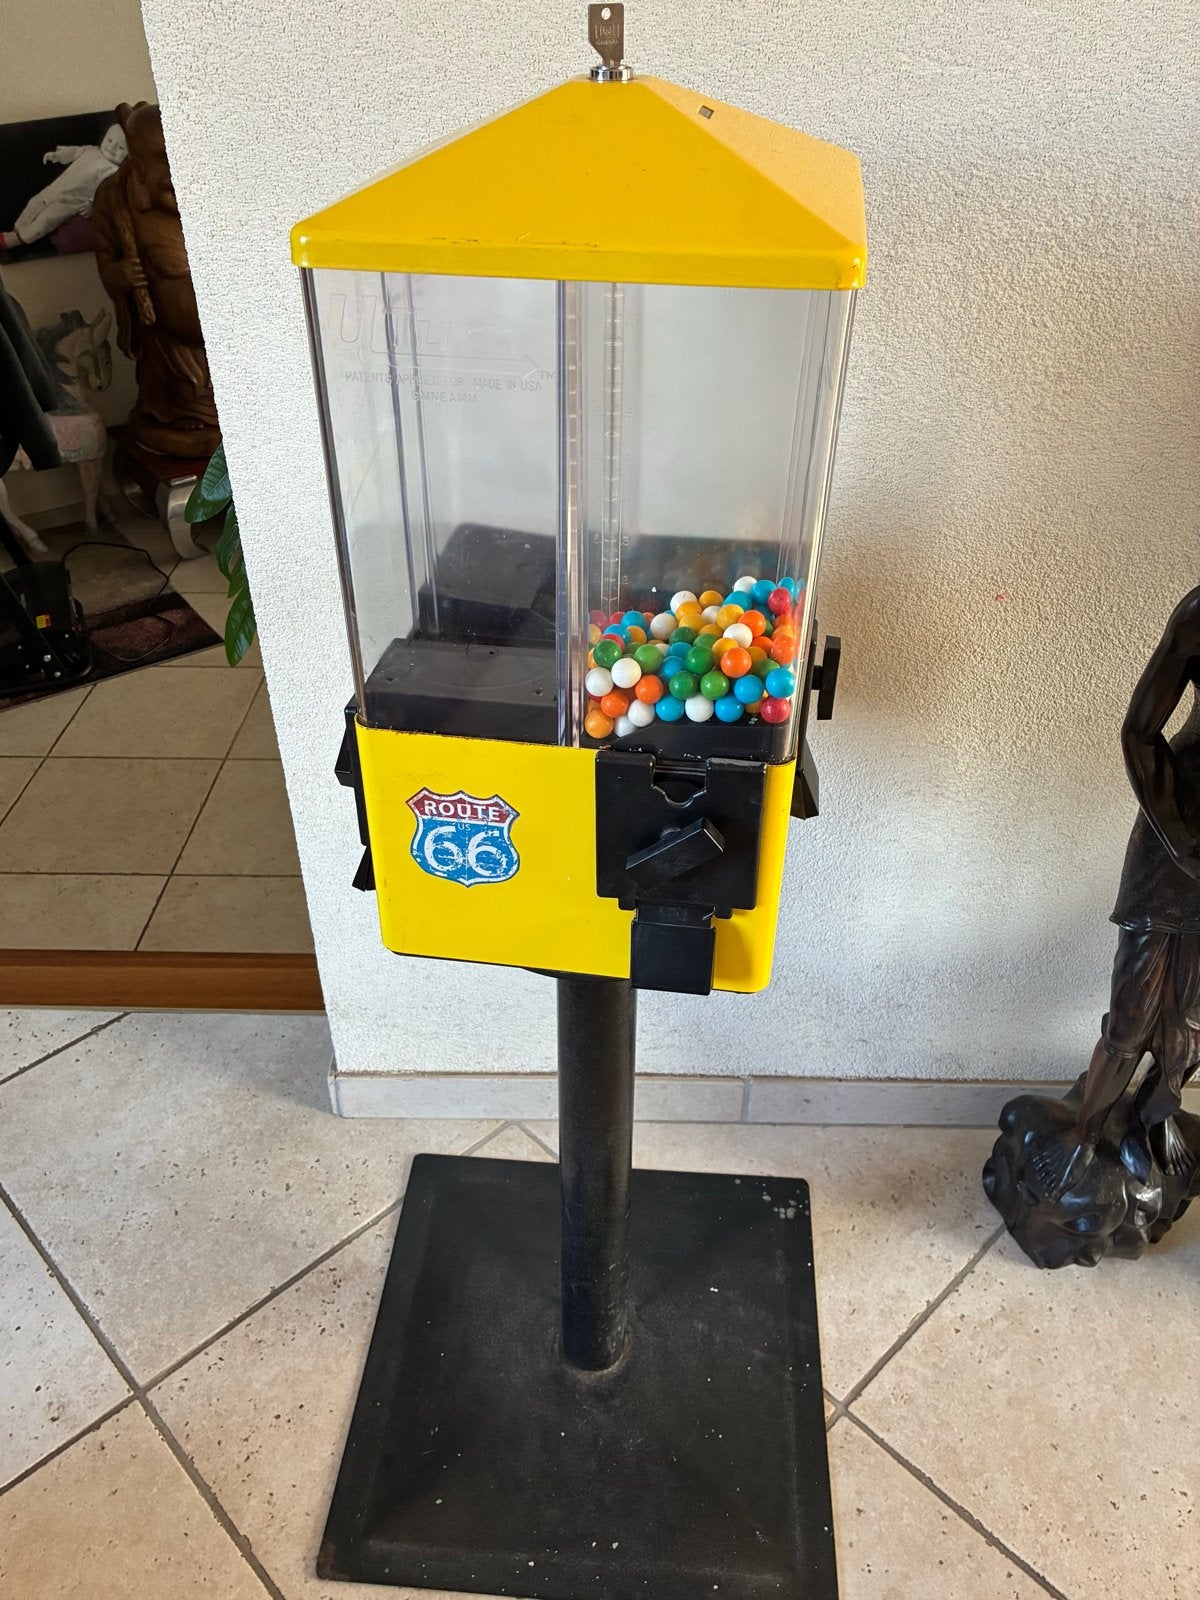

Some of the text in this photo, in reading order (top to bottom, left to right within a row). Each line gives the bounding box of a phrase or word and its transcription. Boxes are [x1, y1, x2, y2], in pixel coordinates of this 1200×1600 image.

[520, 382, 544, 393] USA
[424, 800, 501, 821] ROUTE
[457, 823, 471, 831] US
[424, 825, 507, 877] 66
